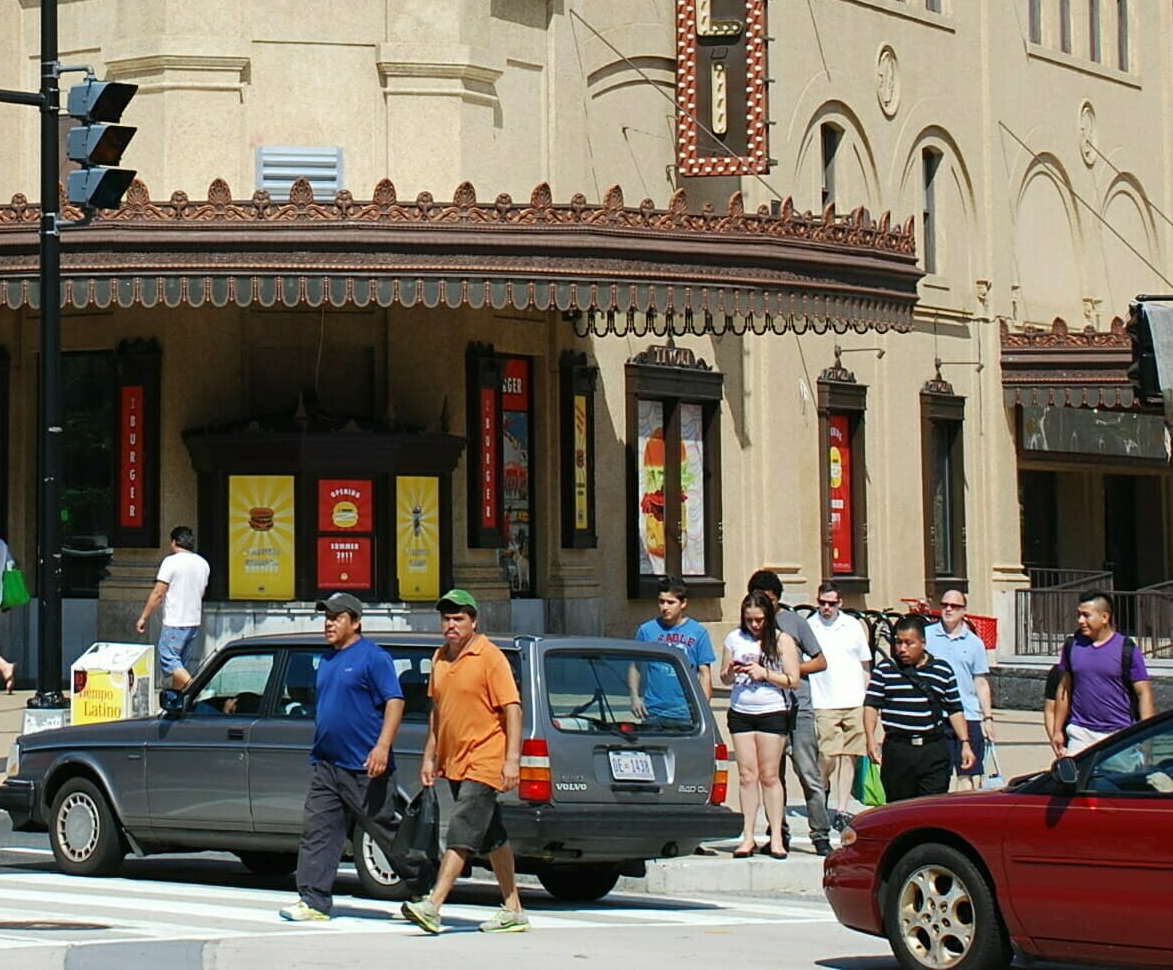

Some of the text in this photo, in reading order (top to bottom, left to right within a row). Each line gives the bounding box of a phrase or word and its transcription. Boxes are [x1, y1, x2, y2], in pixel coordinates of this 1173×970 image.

[330, 488, 361, 499] OPENING
[336, 551, 353, 559] 2011
[84, 702, 122, 718] Latino
[556, 782, 588, 791] VOLVO
